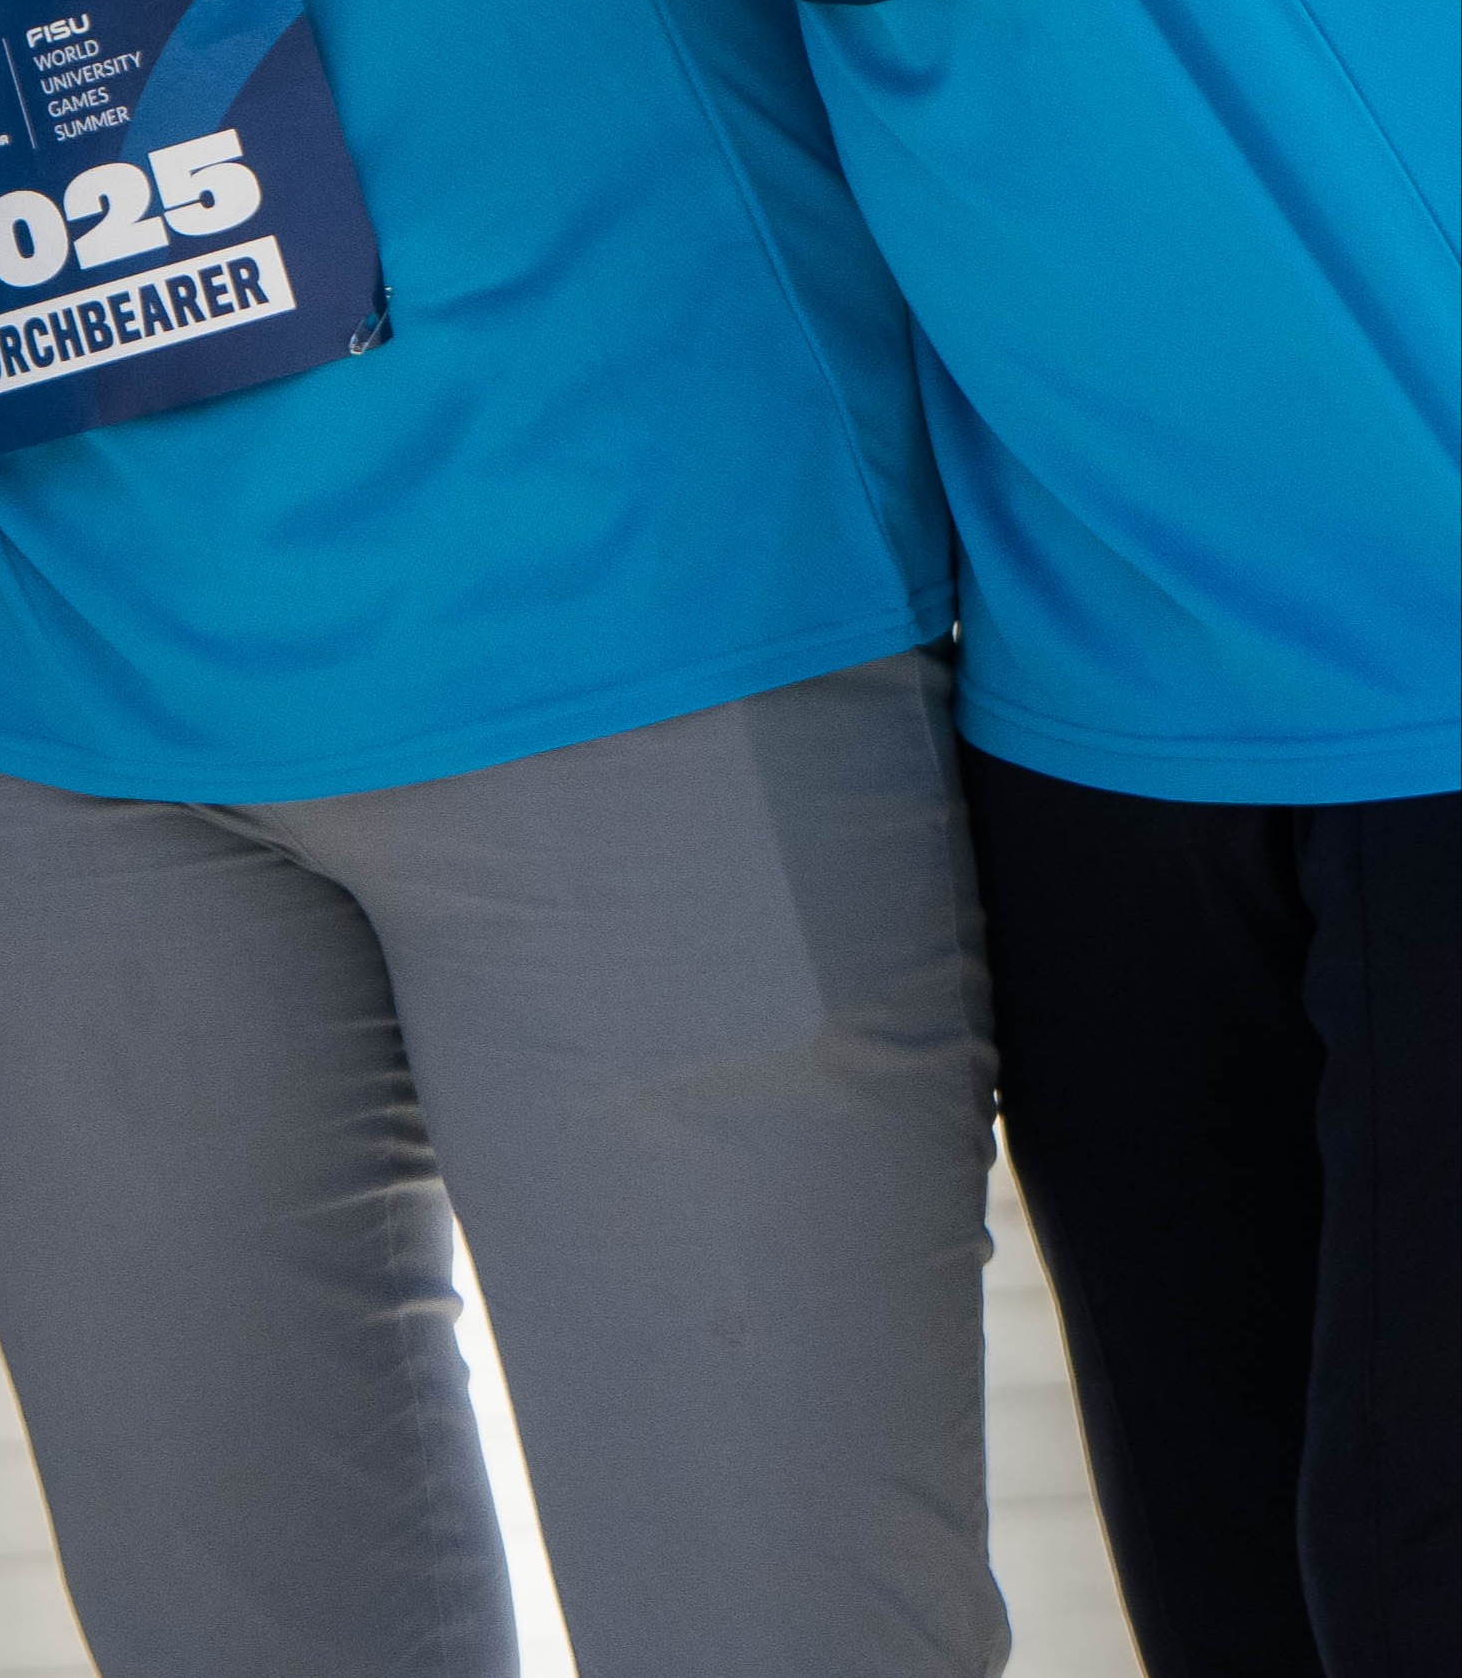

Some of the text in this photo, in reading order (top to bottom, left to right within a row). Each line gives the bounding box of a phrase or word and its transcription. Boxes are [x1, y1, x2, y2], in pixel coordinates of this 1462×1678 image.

[26, 13, 90, 48] FISU
[33, 40, 100, 72] WORLD
[40, 51, 143, 95] UNIVERSITY
[47, 86, 110, 118] GAMES
[53, 106, 130, 142] SUMMER
